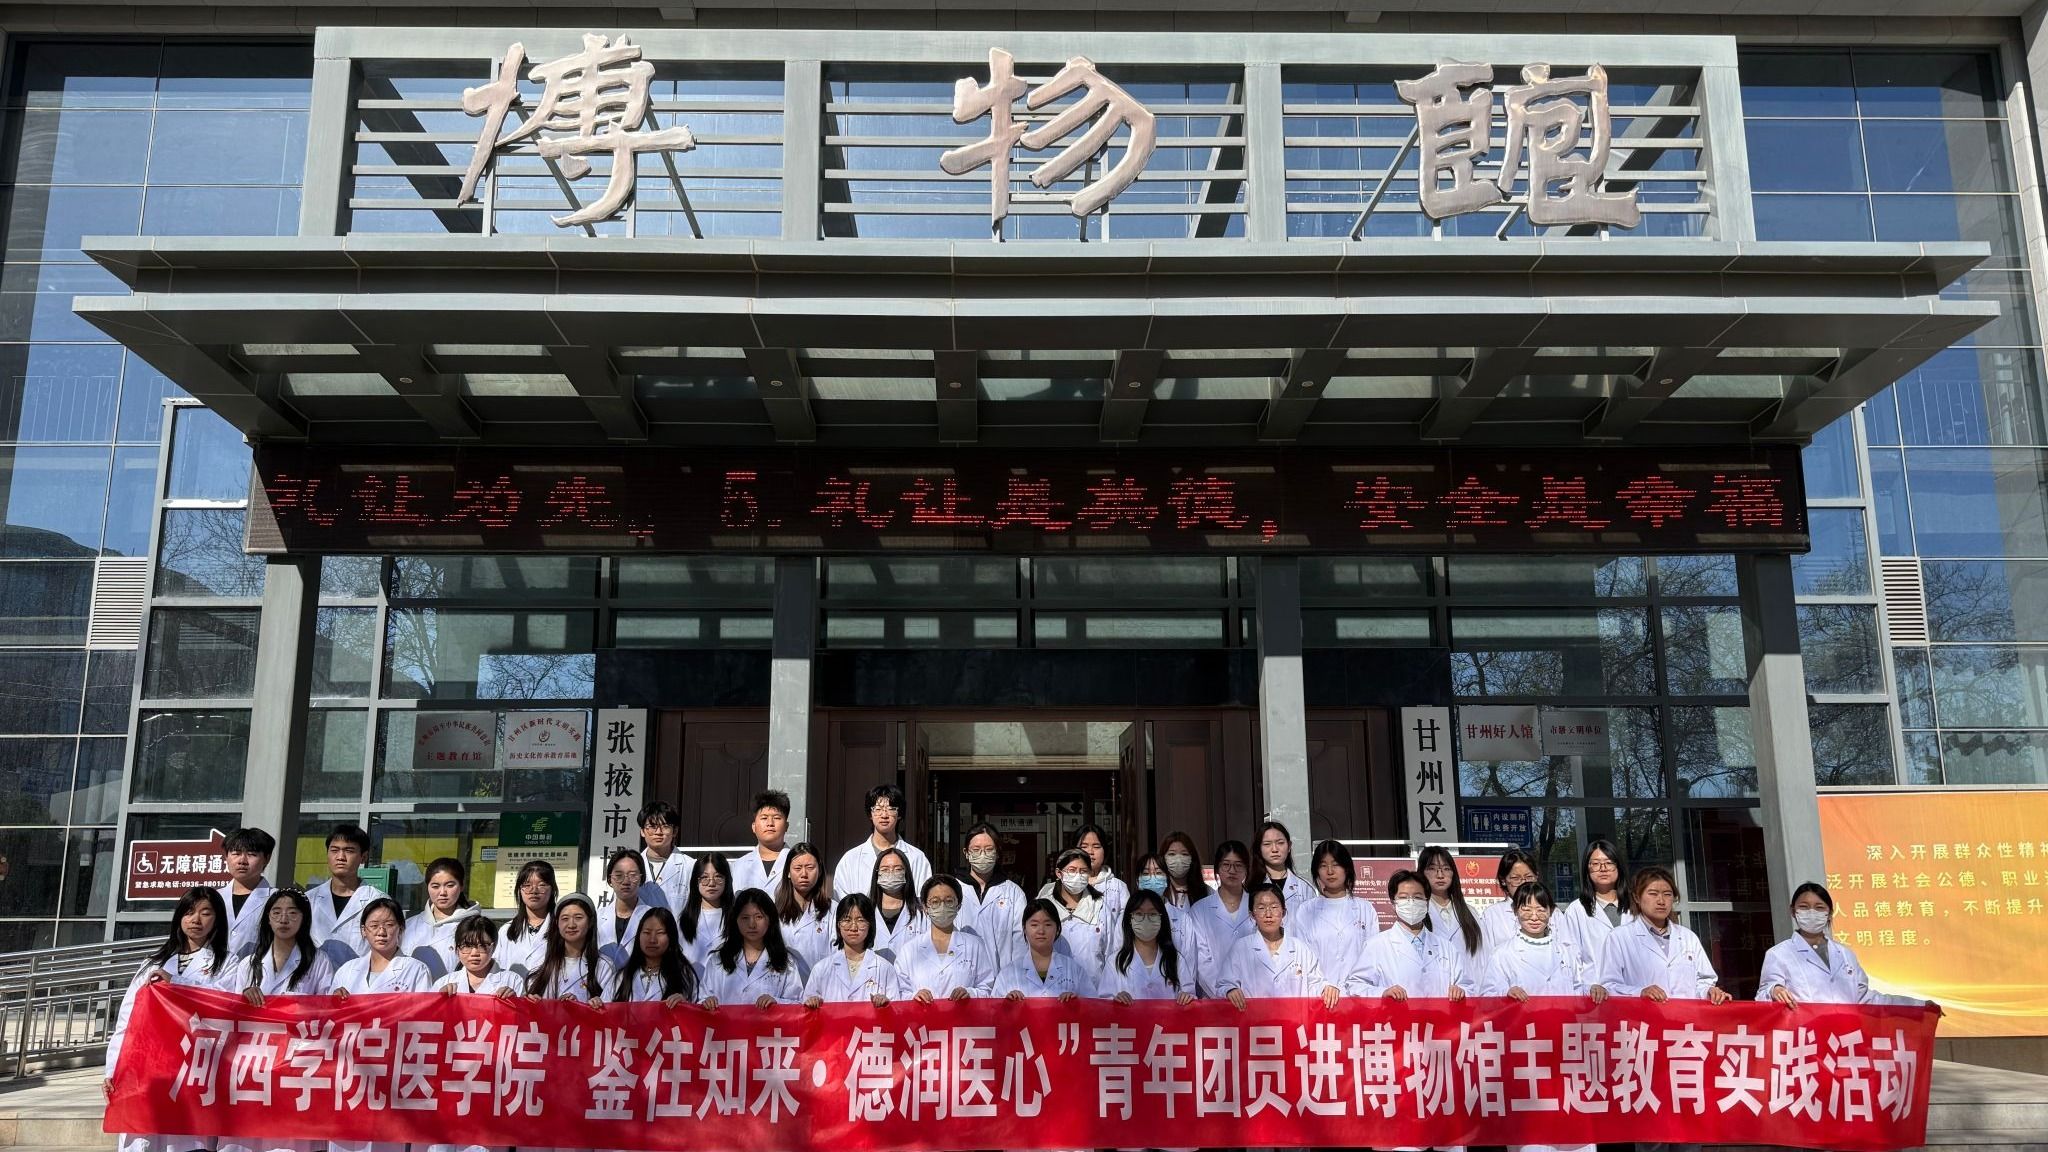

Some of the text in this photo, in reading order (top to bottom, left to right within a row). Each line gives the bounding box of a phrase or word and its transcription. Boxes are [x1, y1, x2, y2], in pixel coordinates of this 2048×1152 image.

[1465, 723, 1534, 739] 甘州好人馆
[427, 751, 482, 761] 主题教育馆
[1413, 718, 1447, 834] 甘州区
[1493, 824, 1527, 832] 免费开放
[160, 854, 229, 875] 无障碍通
[1826, 870, 2048, 890] 泛开展社会公德、职业
[1835, 929, 1932, 947] 文明程度。
